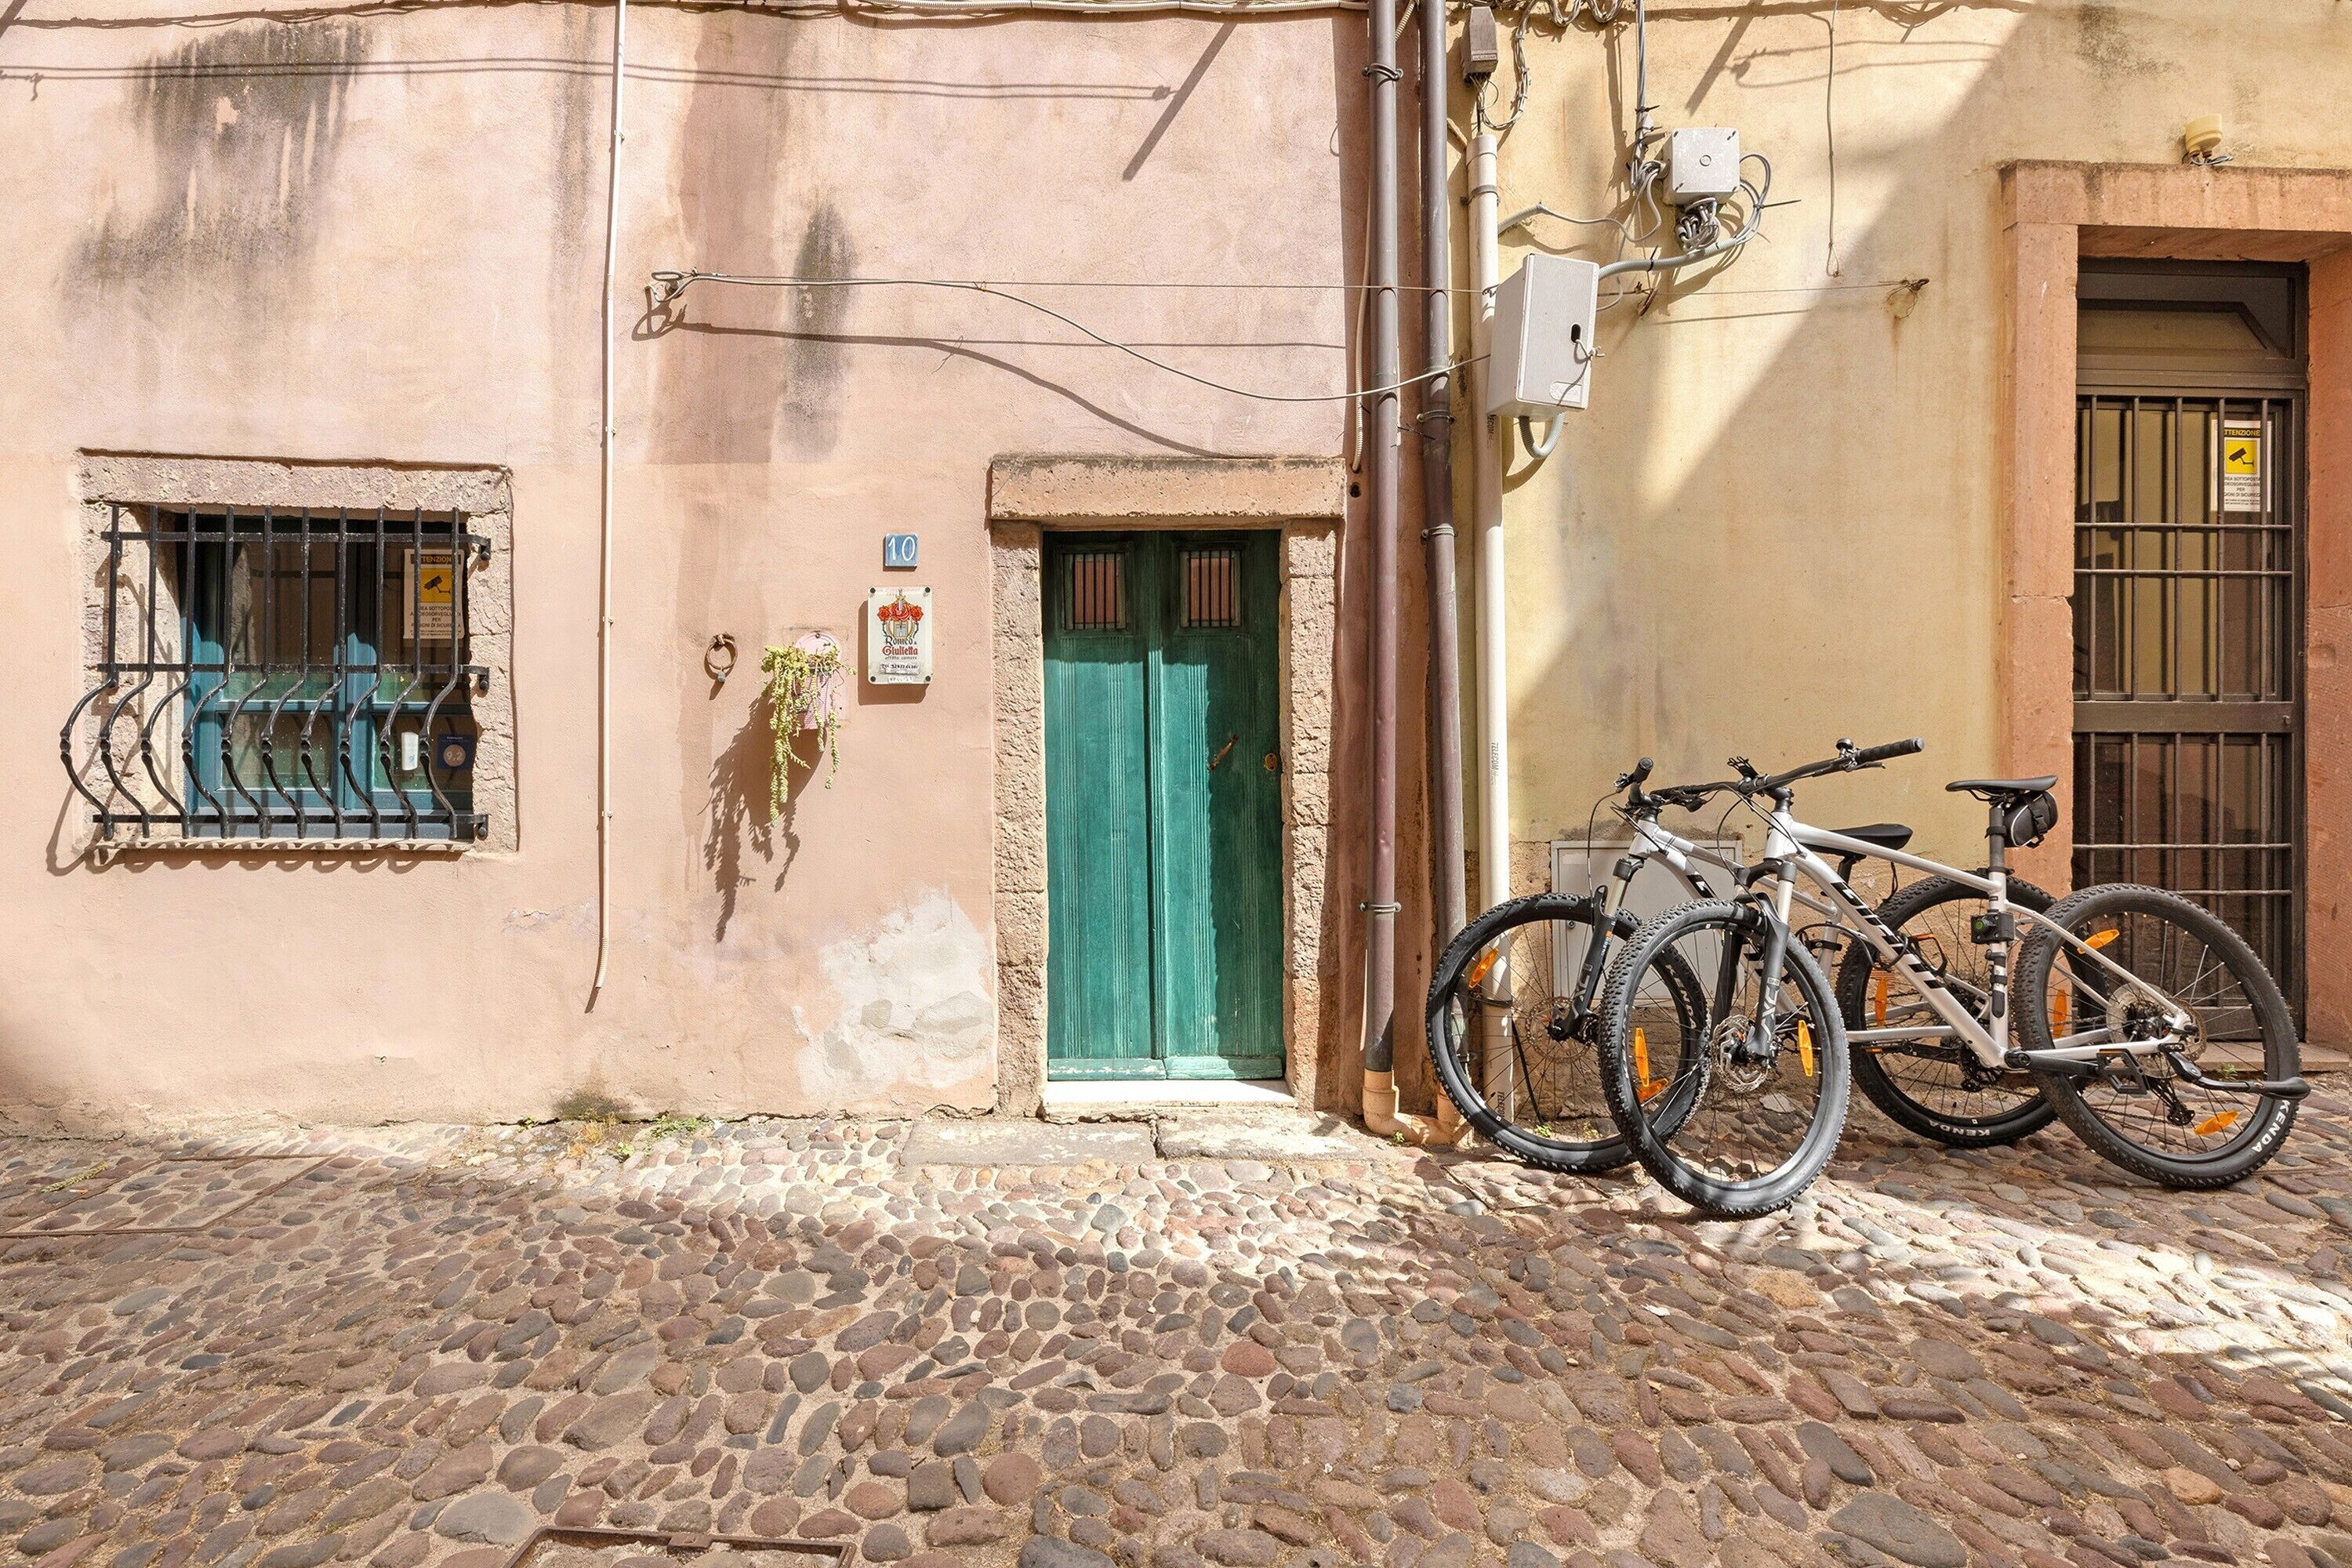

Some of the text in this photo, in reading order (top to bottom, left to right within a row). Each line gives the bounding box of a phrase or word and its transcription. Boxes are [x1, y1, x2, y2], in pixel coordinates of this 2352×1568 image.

[888, 536, 916, 561] 10
[882, 645, 918, 655] Giulietta
[1664, 964, 1697, 1029] KENDA
[1929, 1119, 1991, 1137] KENDA
[2251, 1099, 2291, 1153] KENDA
